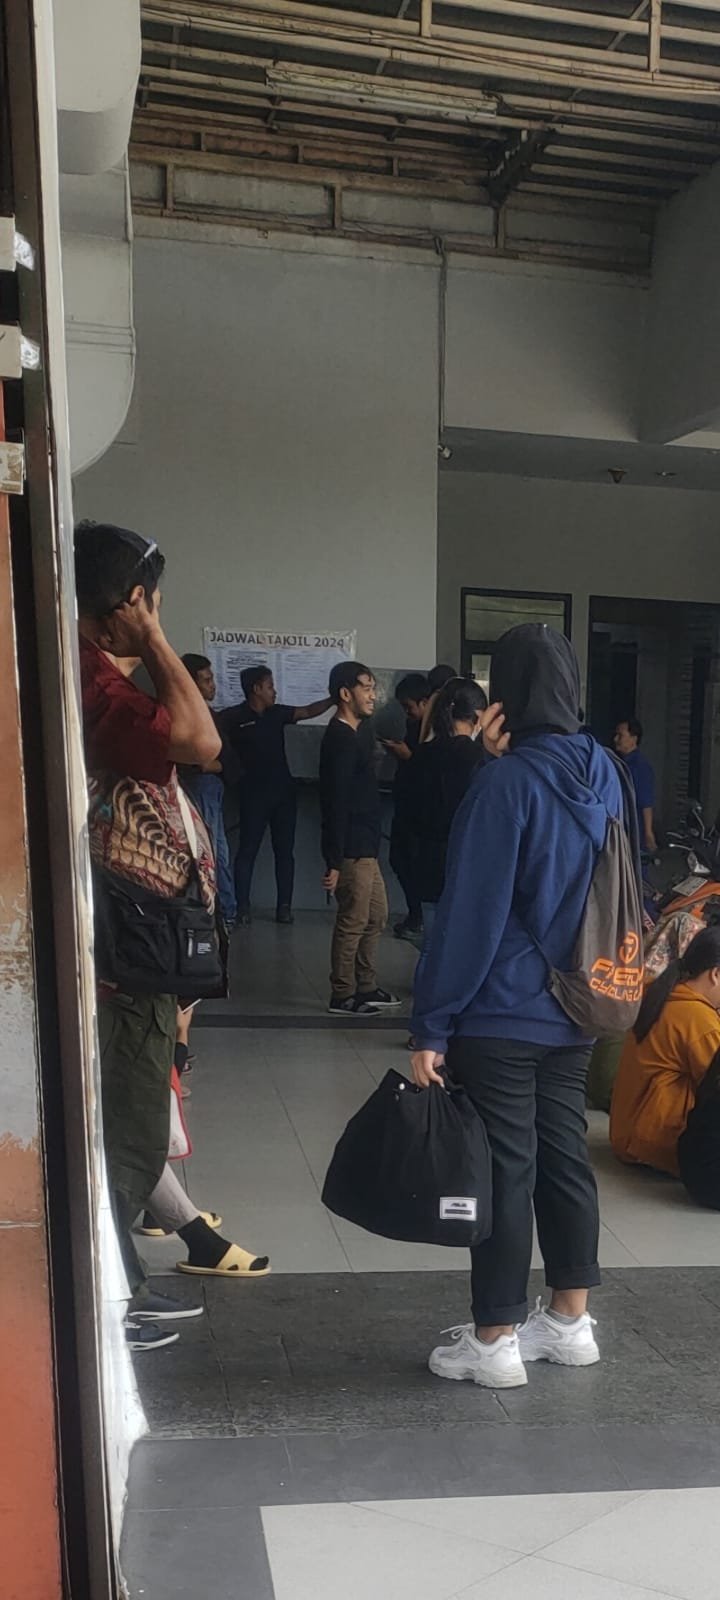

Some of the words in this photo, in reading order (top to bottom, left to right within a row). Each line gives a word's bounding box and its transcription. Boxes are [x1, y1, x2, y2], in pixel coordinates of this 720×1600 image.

[209, 631, 265, 645] JADWAL
[267, 635, 310, 647] TAKJIL
[314, 637, 345, 649] 2024
